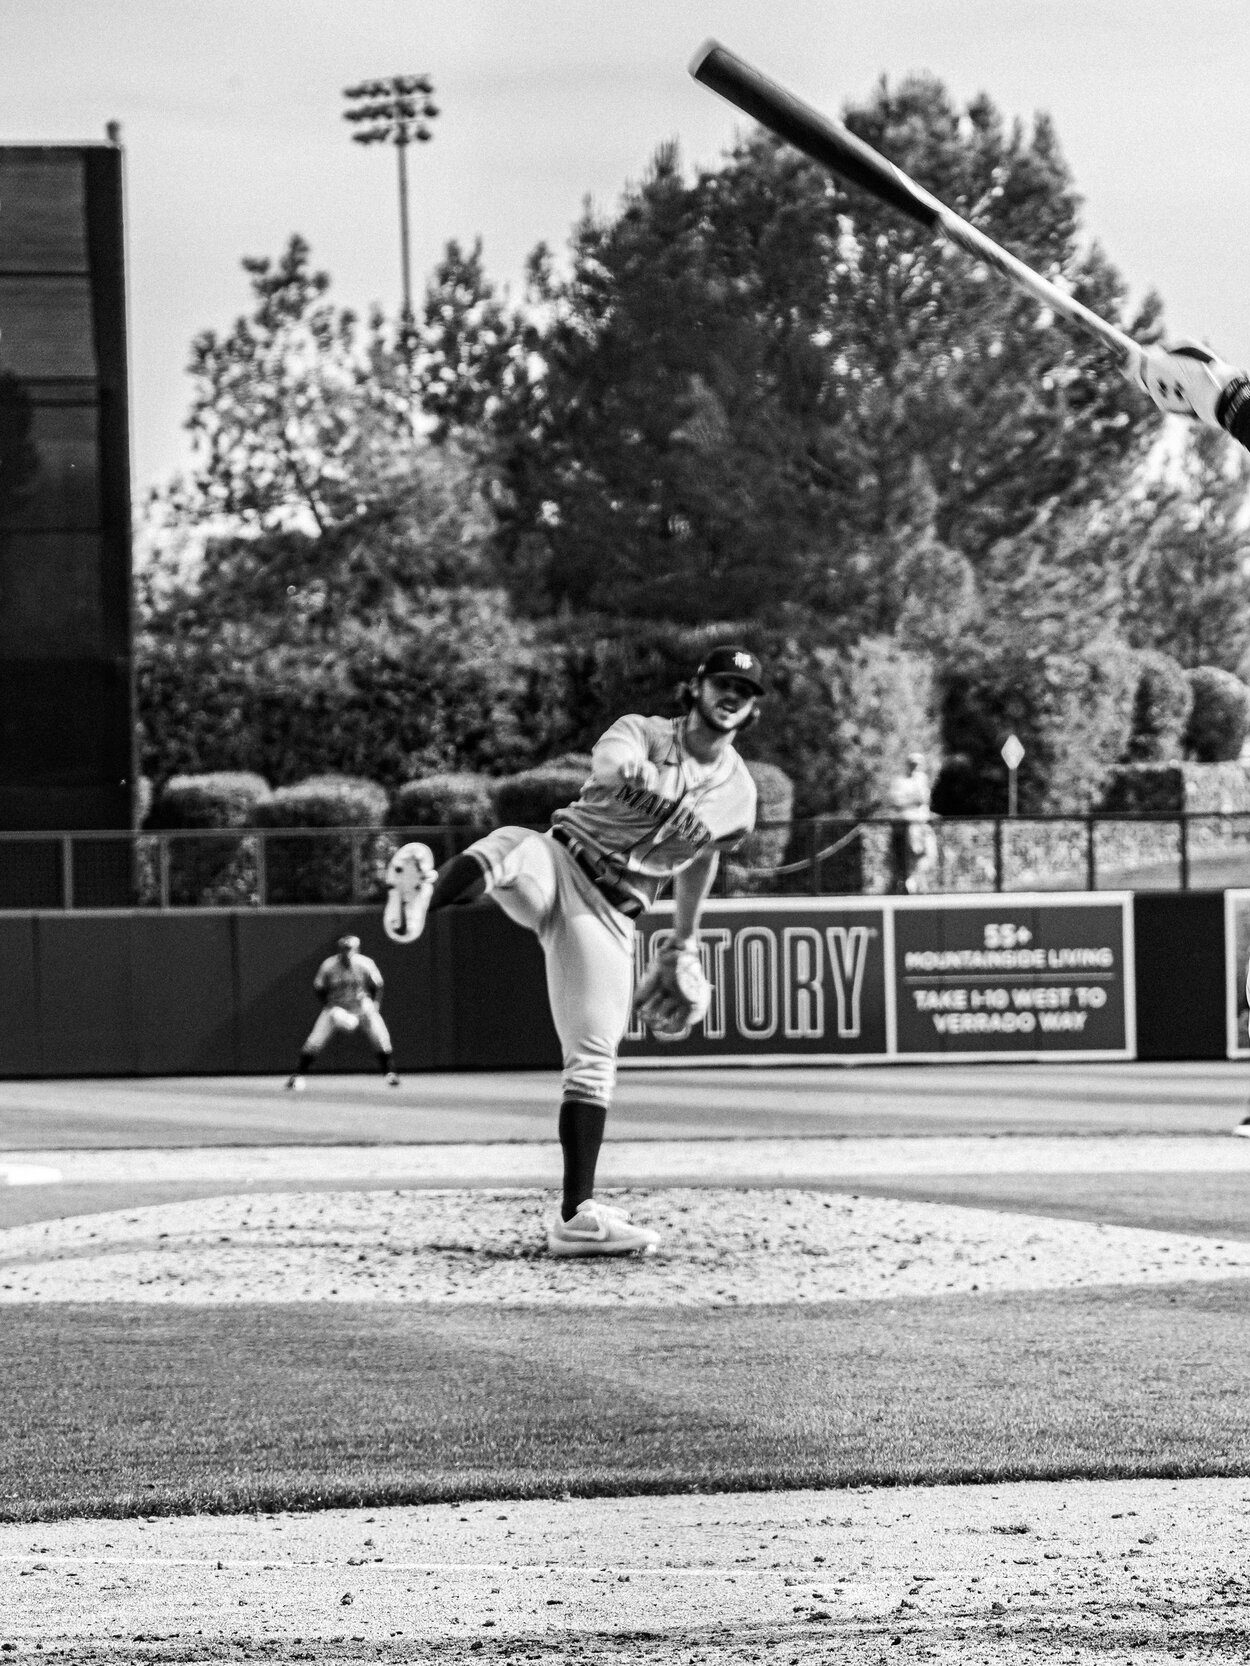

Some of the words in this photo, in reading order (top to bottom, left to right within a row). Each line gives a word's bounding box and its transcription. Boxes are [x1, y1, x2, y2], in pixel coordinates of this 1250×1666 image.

[984, 923, 1032, 949] 55+
[904, 949, 1047, 971] MOUNTAINSIDE
[1047, 947, 1114, 969] LIVING
[913, 988, 968, 1011] TAKE
[1011, 987, 1073, 1010] WEST
[1074, 986, 1107, 1009] TO
[932, 1011, 1036, 1034] VERRADO
[1038, 1010, 1088, 1033] WAY
